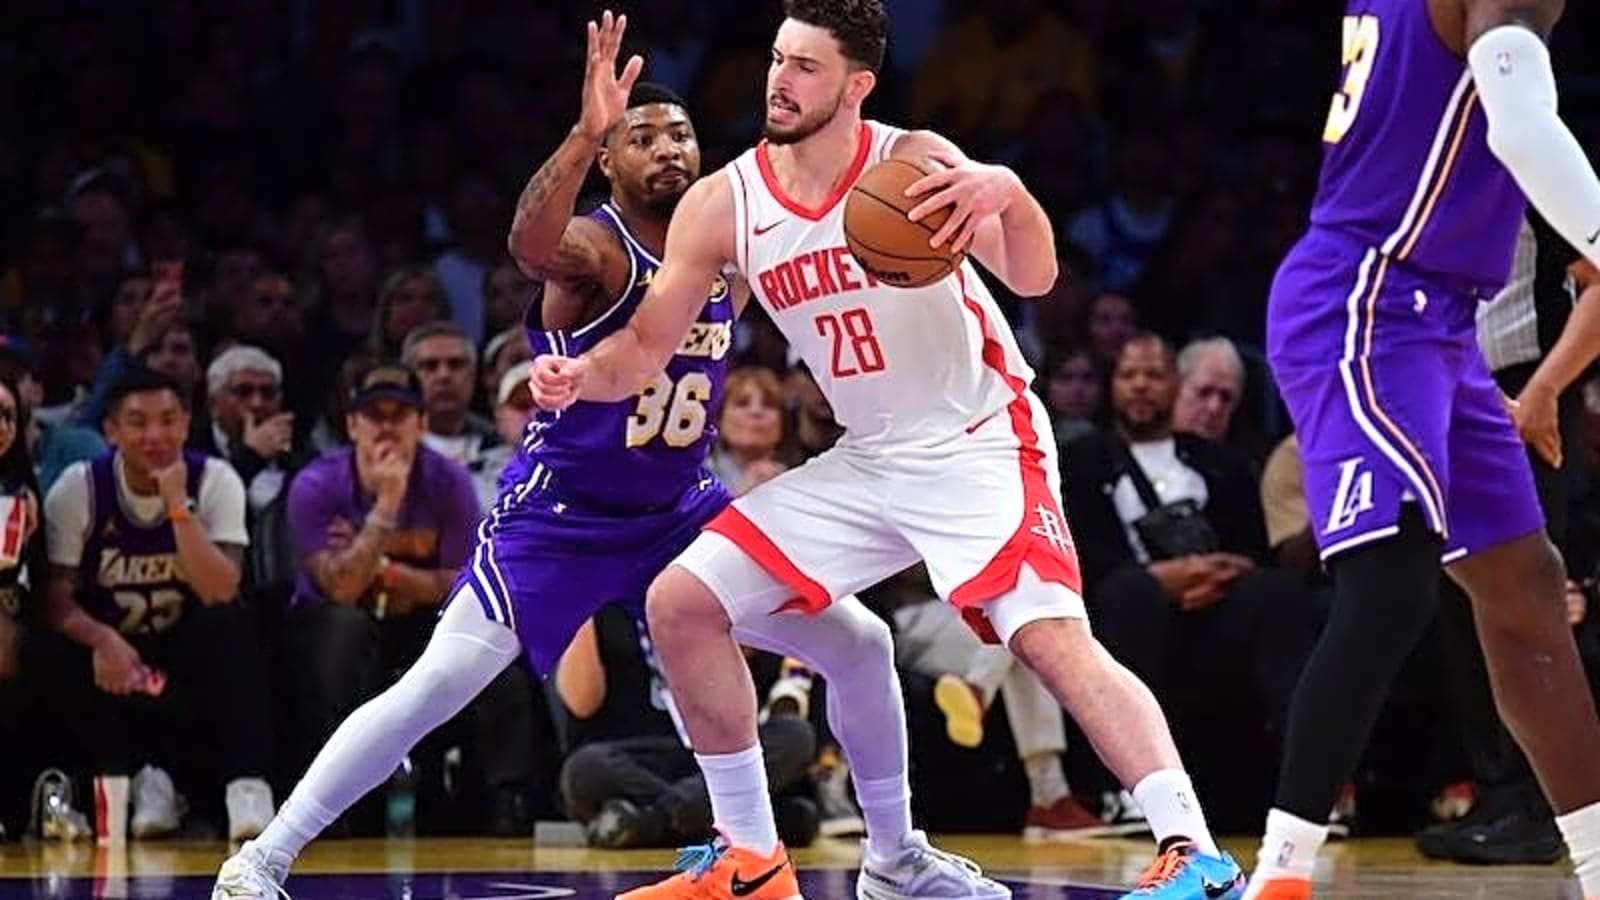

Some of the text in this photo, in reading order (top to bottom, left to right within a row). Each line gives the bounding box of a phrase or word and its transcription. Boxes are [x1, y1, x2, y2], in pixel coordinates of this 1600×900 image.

[758, 246, 878, 312] ROCKE
[676, 320, 732, 360] ERS
[815, 308, 885, 378] 28
[626, 371, 713, 448] 36
[1321, 455, 1375, 536] LA
[98, 547, 186, 588] LAKER
